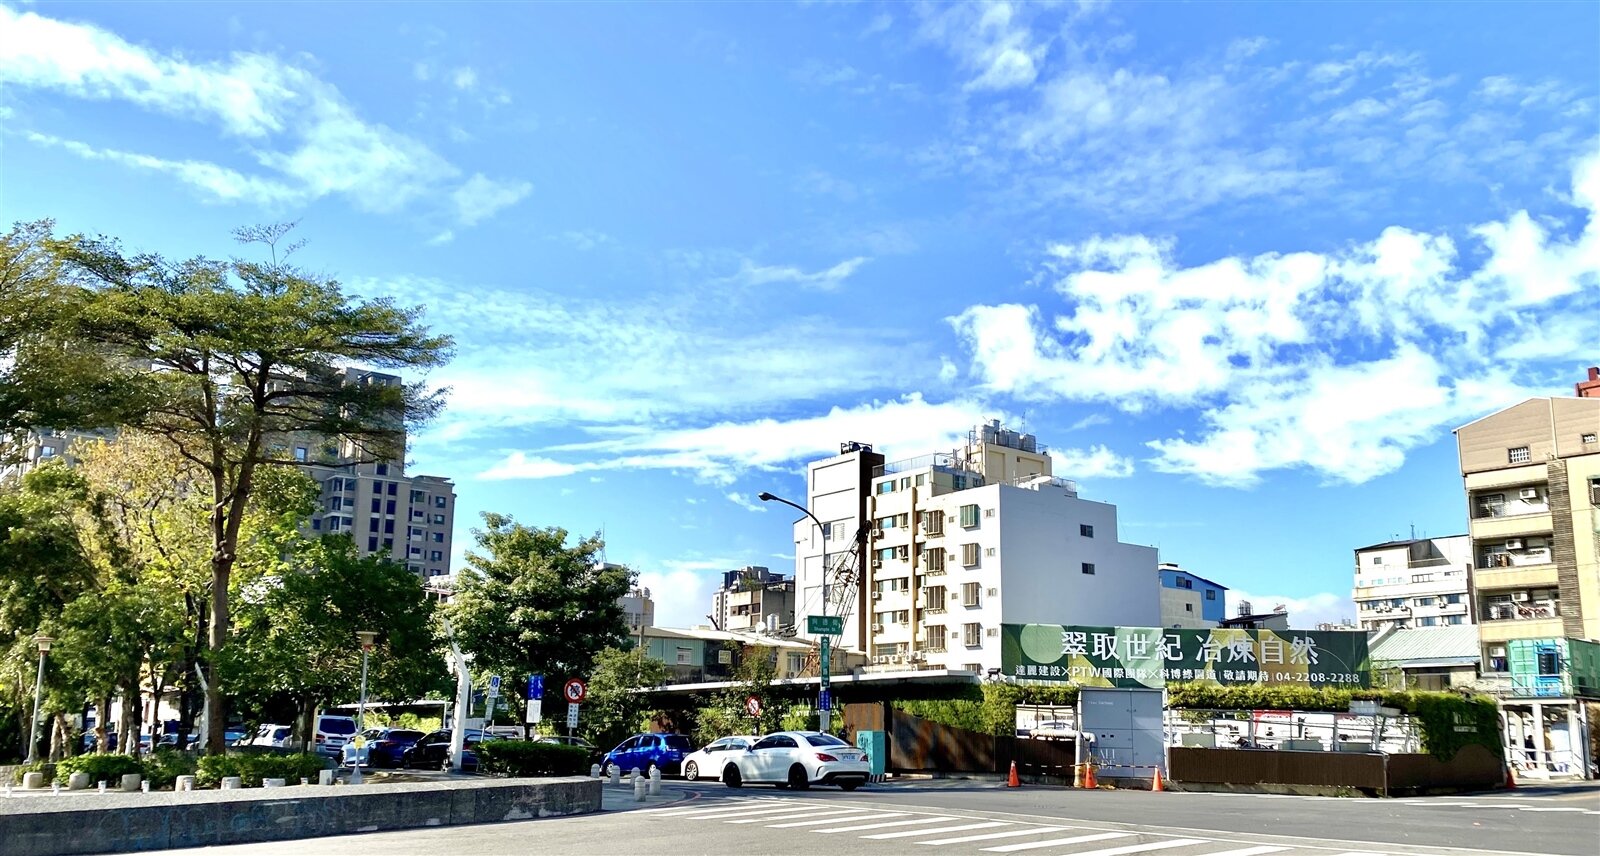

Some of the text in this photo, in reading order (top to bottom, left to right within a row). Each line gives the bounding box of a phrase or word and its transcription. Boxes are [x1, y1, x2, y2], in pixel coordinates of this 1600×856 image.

[1061, 631, 1319, 665] 翠取世紀 冶煉自然
[1223, 669, 1269, 681] 敬請期待
[1275, 671, 1360, 683] 04-2208-2288
